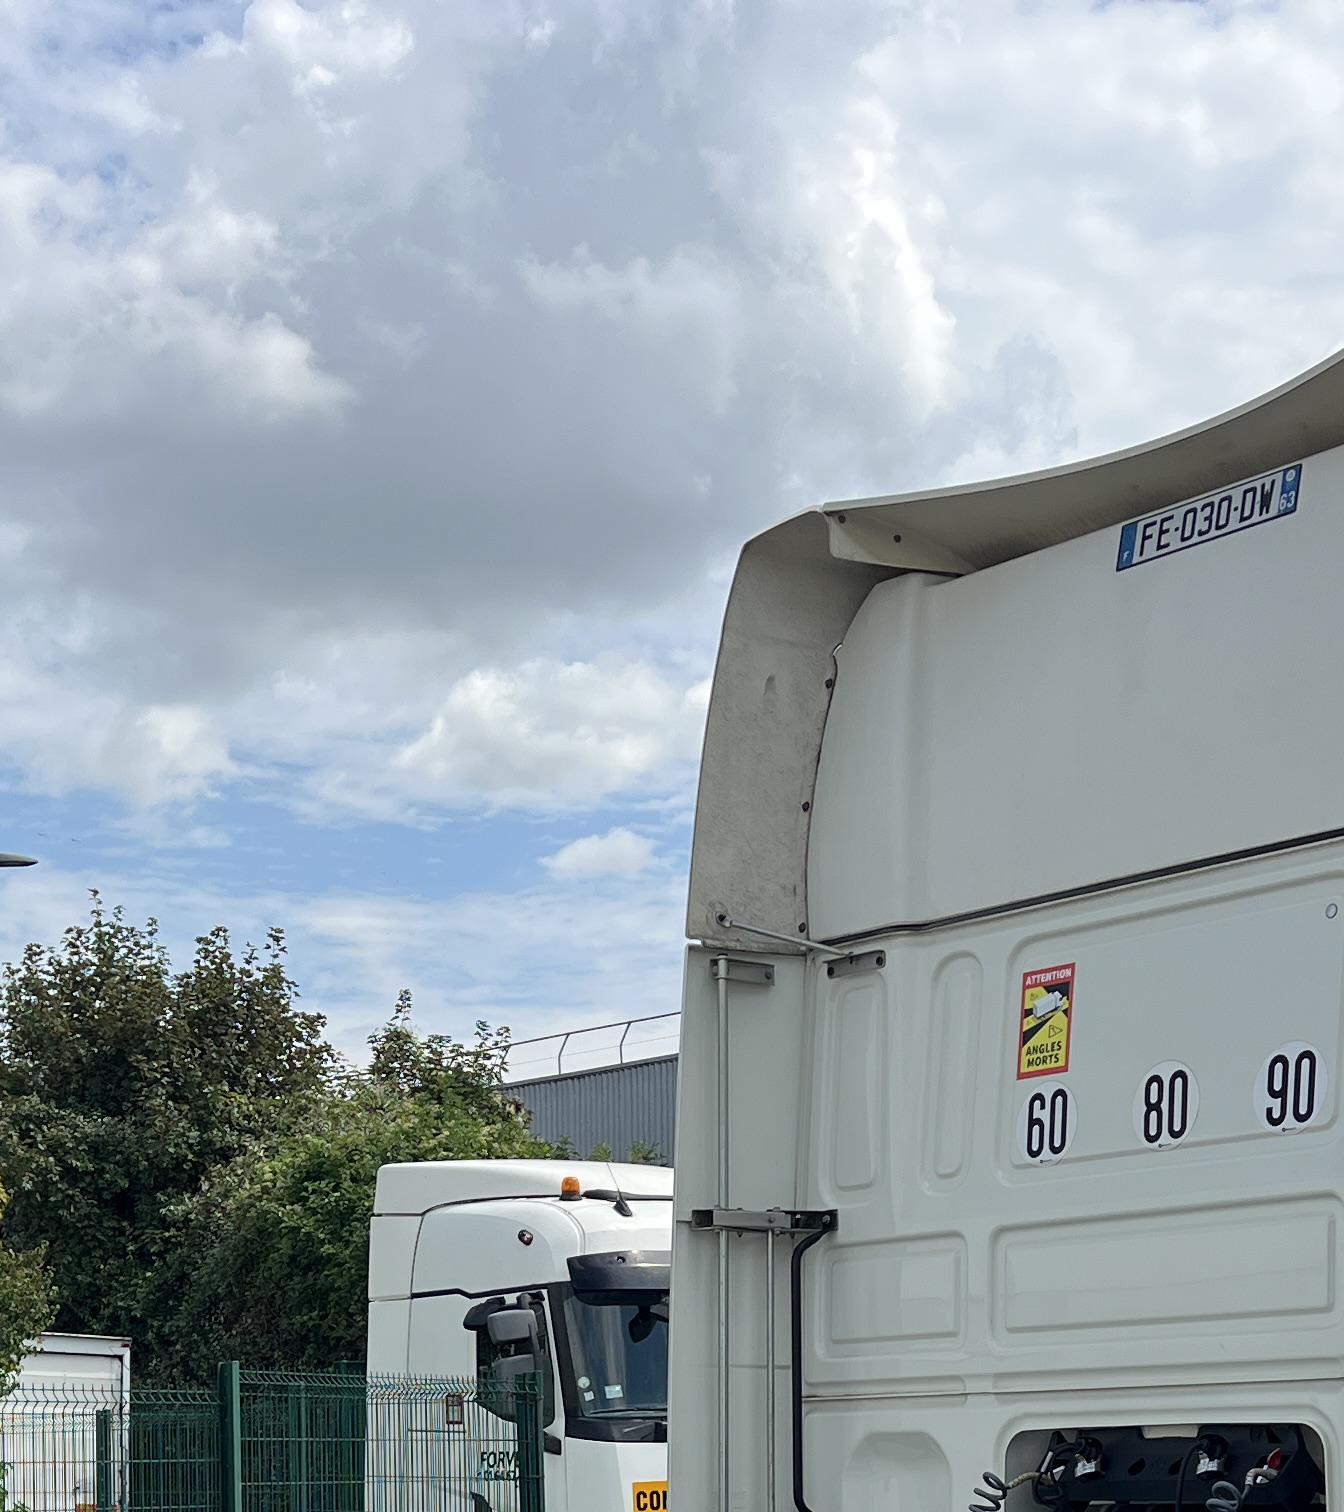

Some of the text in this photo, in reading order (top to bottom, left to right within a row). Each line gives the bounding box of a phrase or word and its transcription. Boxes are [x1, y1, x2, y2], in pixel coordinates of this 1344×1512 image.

[1279, 490, 1296, 510] 63
[1025, 967, 1072, 986] ATTENTION
[1025, 1040, 1062, 1057] ANGLES
[1026, 1052, 1060, 1069] MORTS
[1265, 1049, 1317, 1127] 90
[1143, 1069, 1189, 1144] 80
[1026, 1088, 1068, 1158] 60
